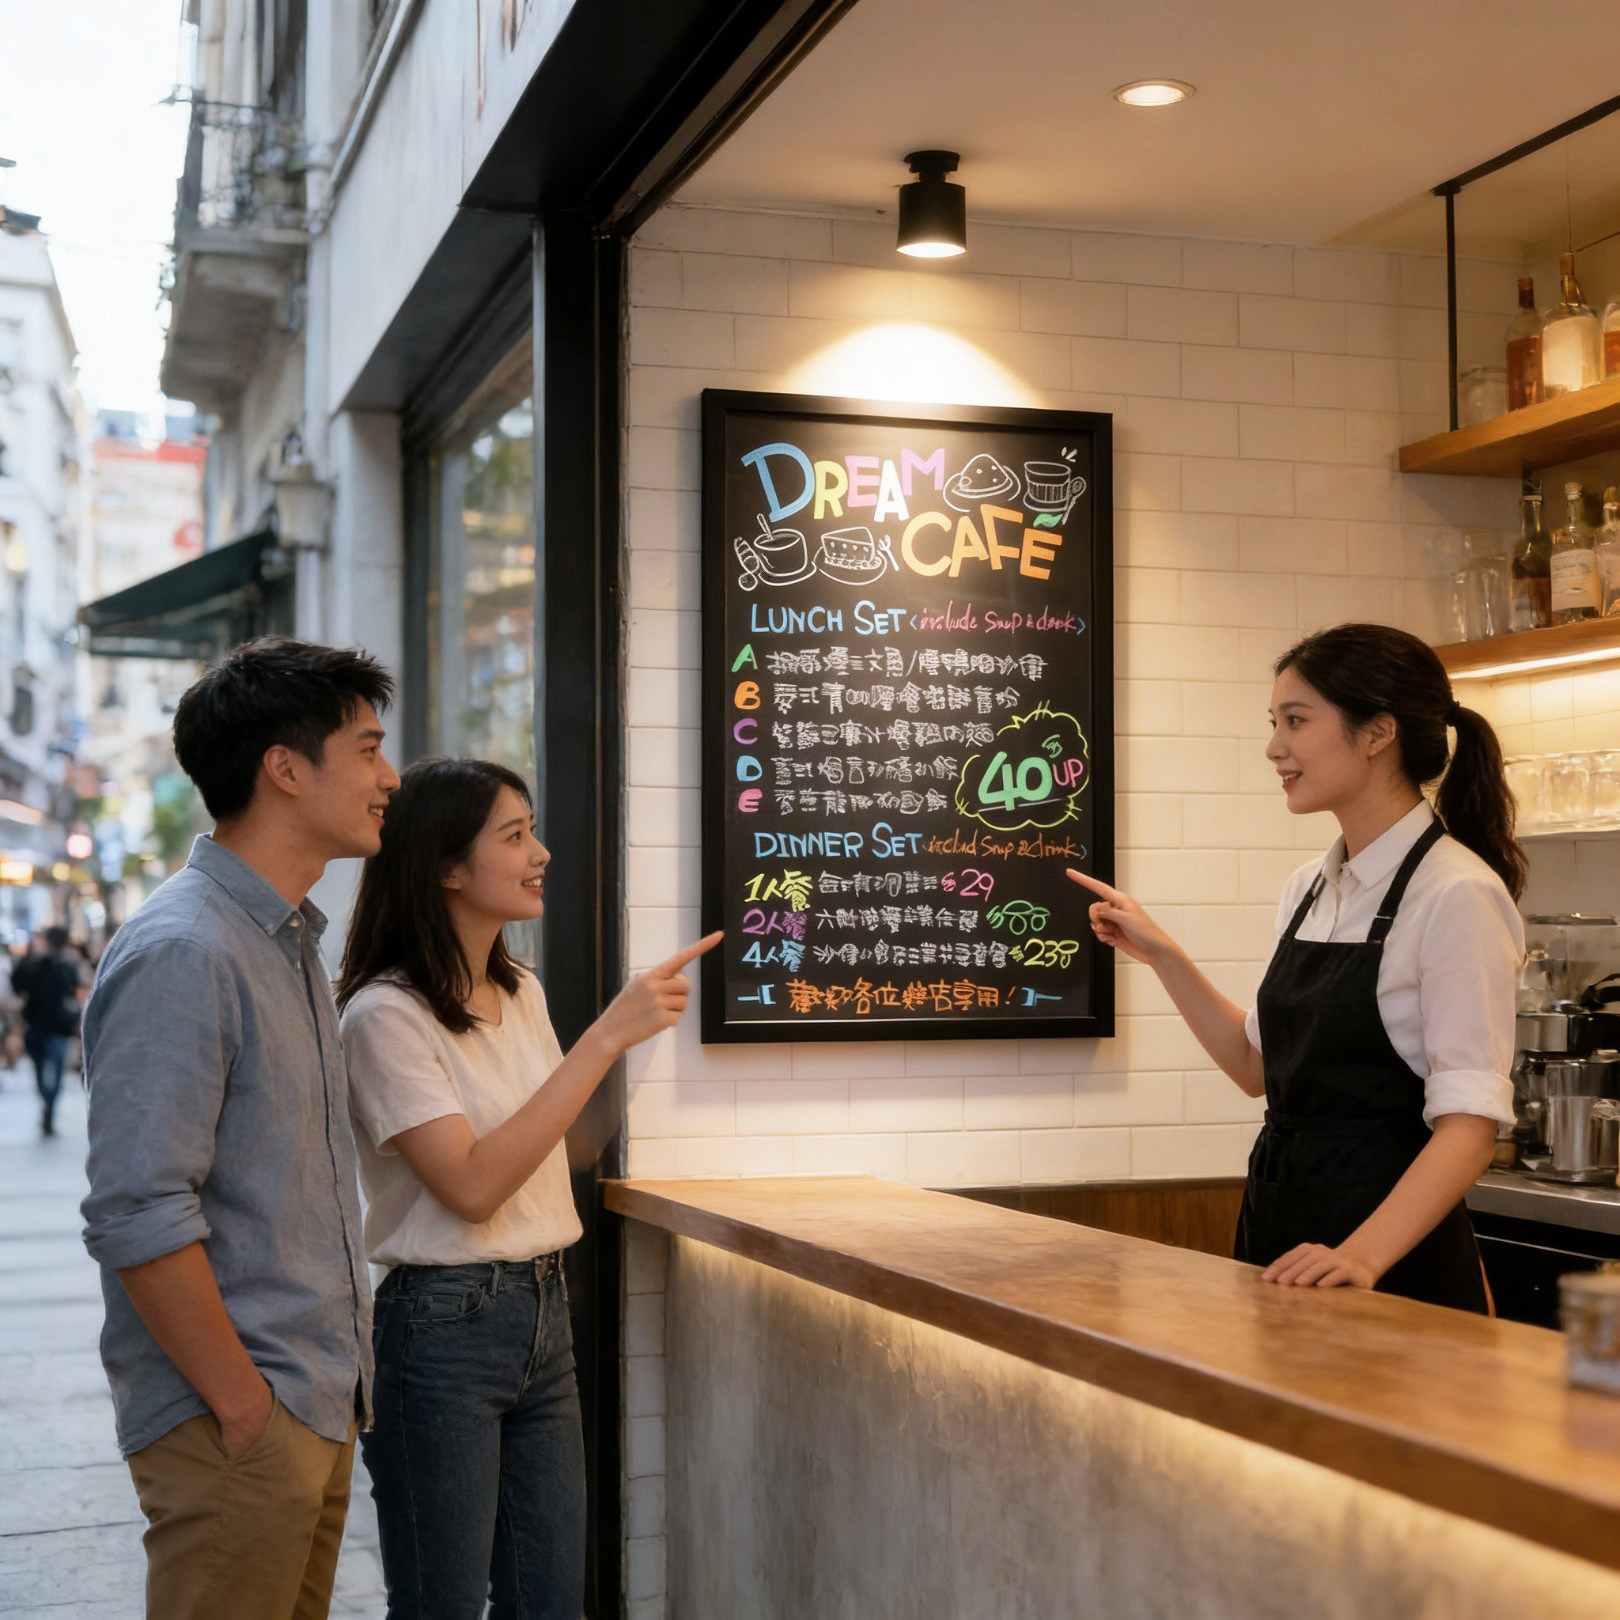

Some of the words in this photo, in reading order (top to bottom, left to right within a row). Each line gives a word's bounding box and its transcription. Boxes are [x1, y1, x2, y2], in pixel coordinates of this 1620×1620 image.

[741, 442, 945, 522] DREAM
[751, 603, 843, 634] LUNCH
[854, 600, 907, 635] SET
[731, 643, 758, 672] A
[734, 681, 761, 710] B
[733, 717, 758, 745] C
[736, 755, 763, 782] D
[978, 751, 1053, 811] 40
[1052, 758, 1084, 788] UP
[738, 788, 763, 812] E
[754, 832, 864, 858] DINNER
[871, 821, 923, 859] SET
